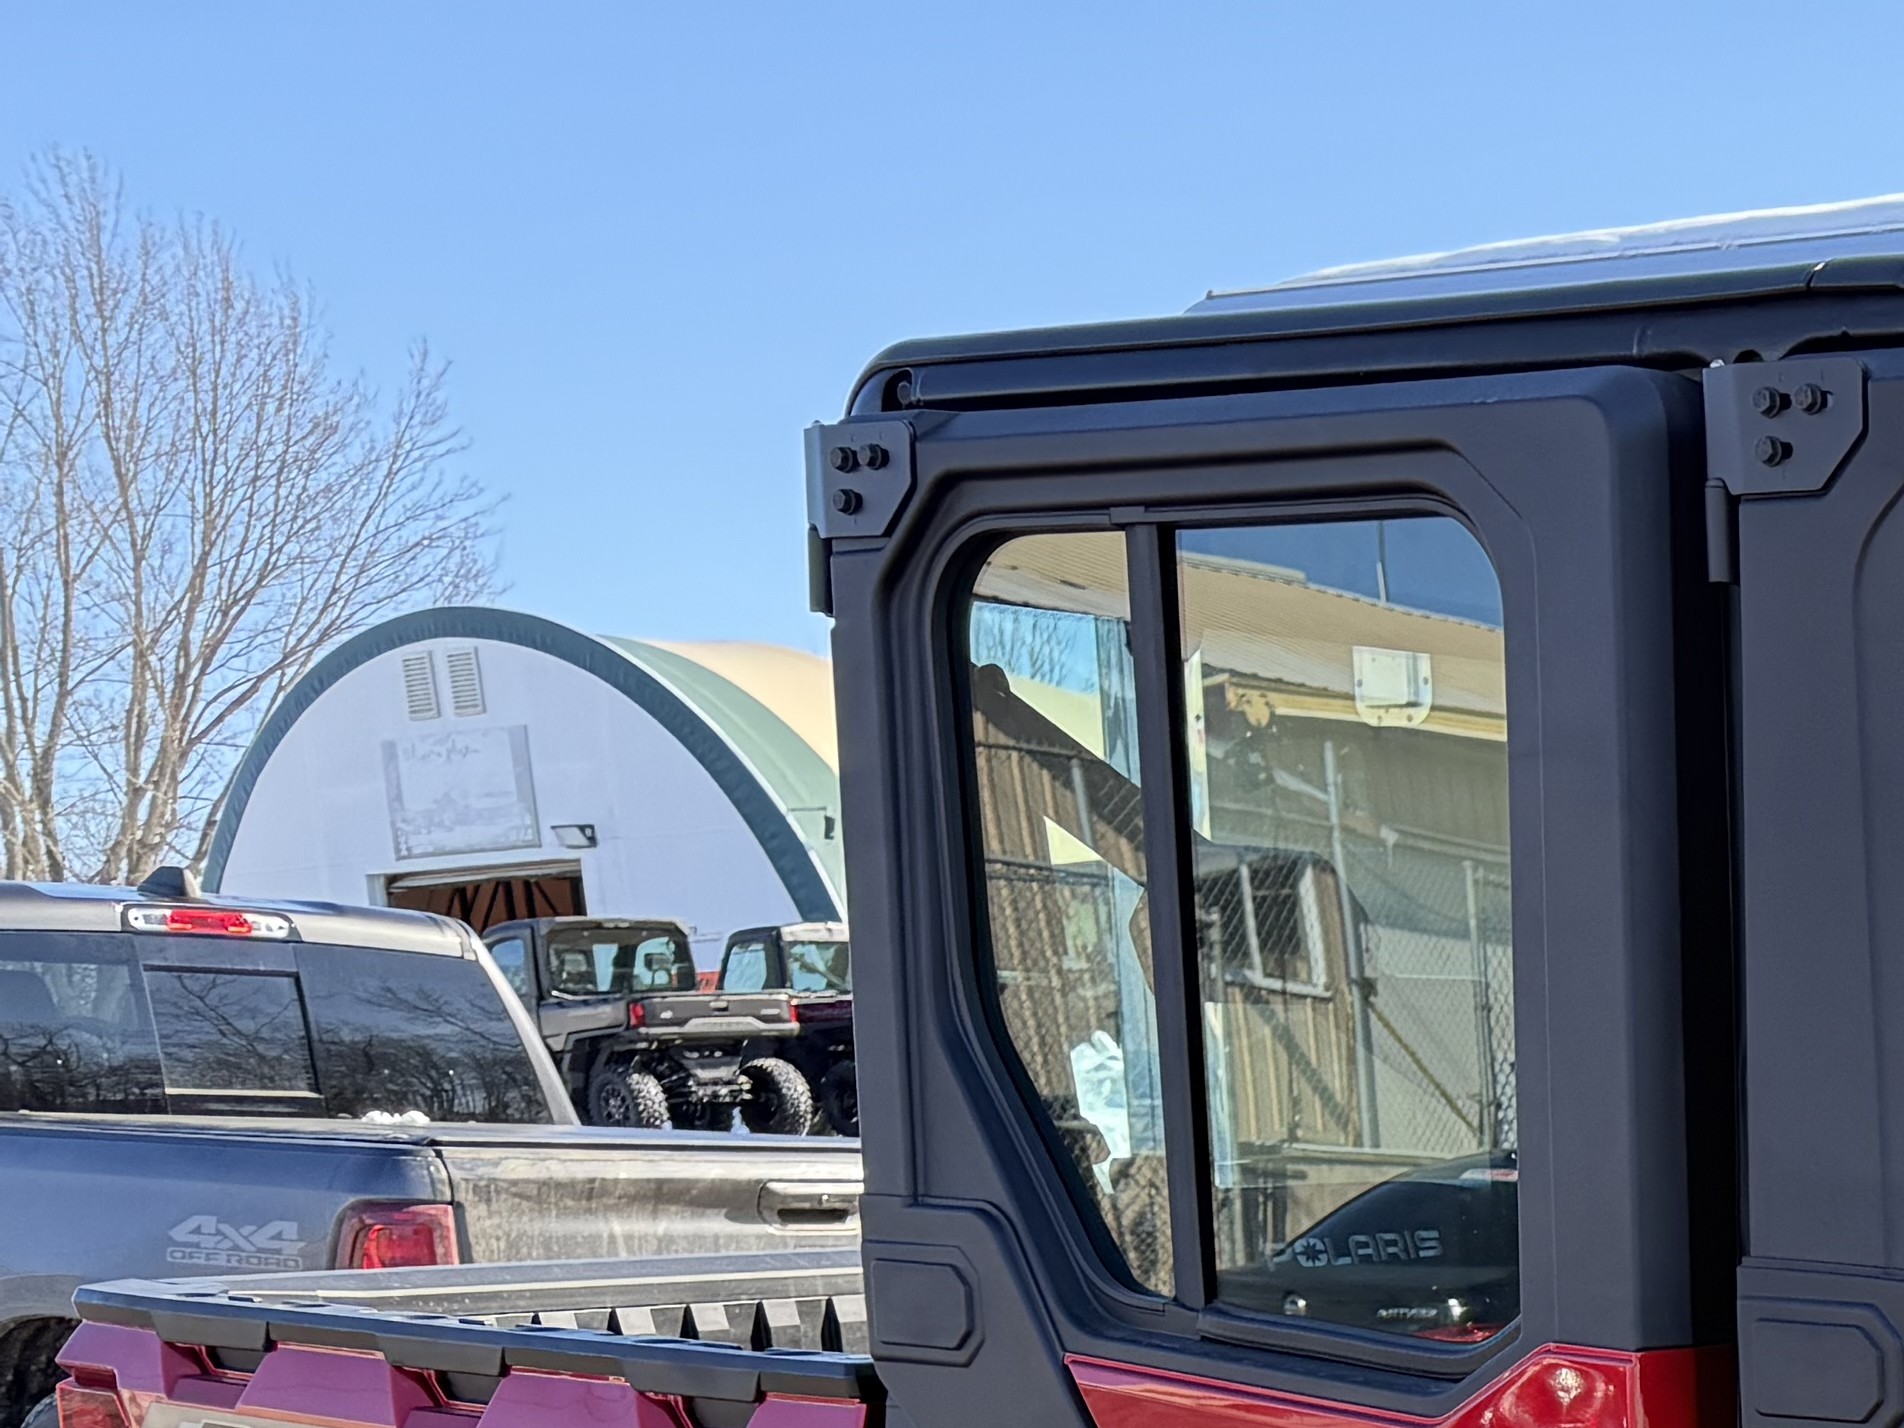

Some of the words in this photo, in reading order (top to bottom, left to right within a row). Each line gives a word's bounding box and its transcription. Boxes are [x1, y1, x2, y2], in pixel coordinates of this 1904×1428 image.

[169, 1249, 220, 1263] OFF
[225, 1253, 301, 1270] ROAD
[1264, 1228, 1443, 1272] POLARIS
